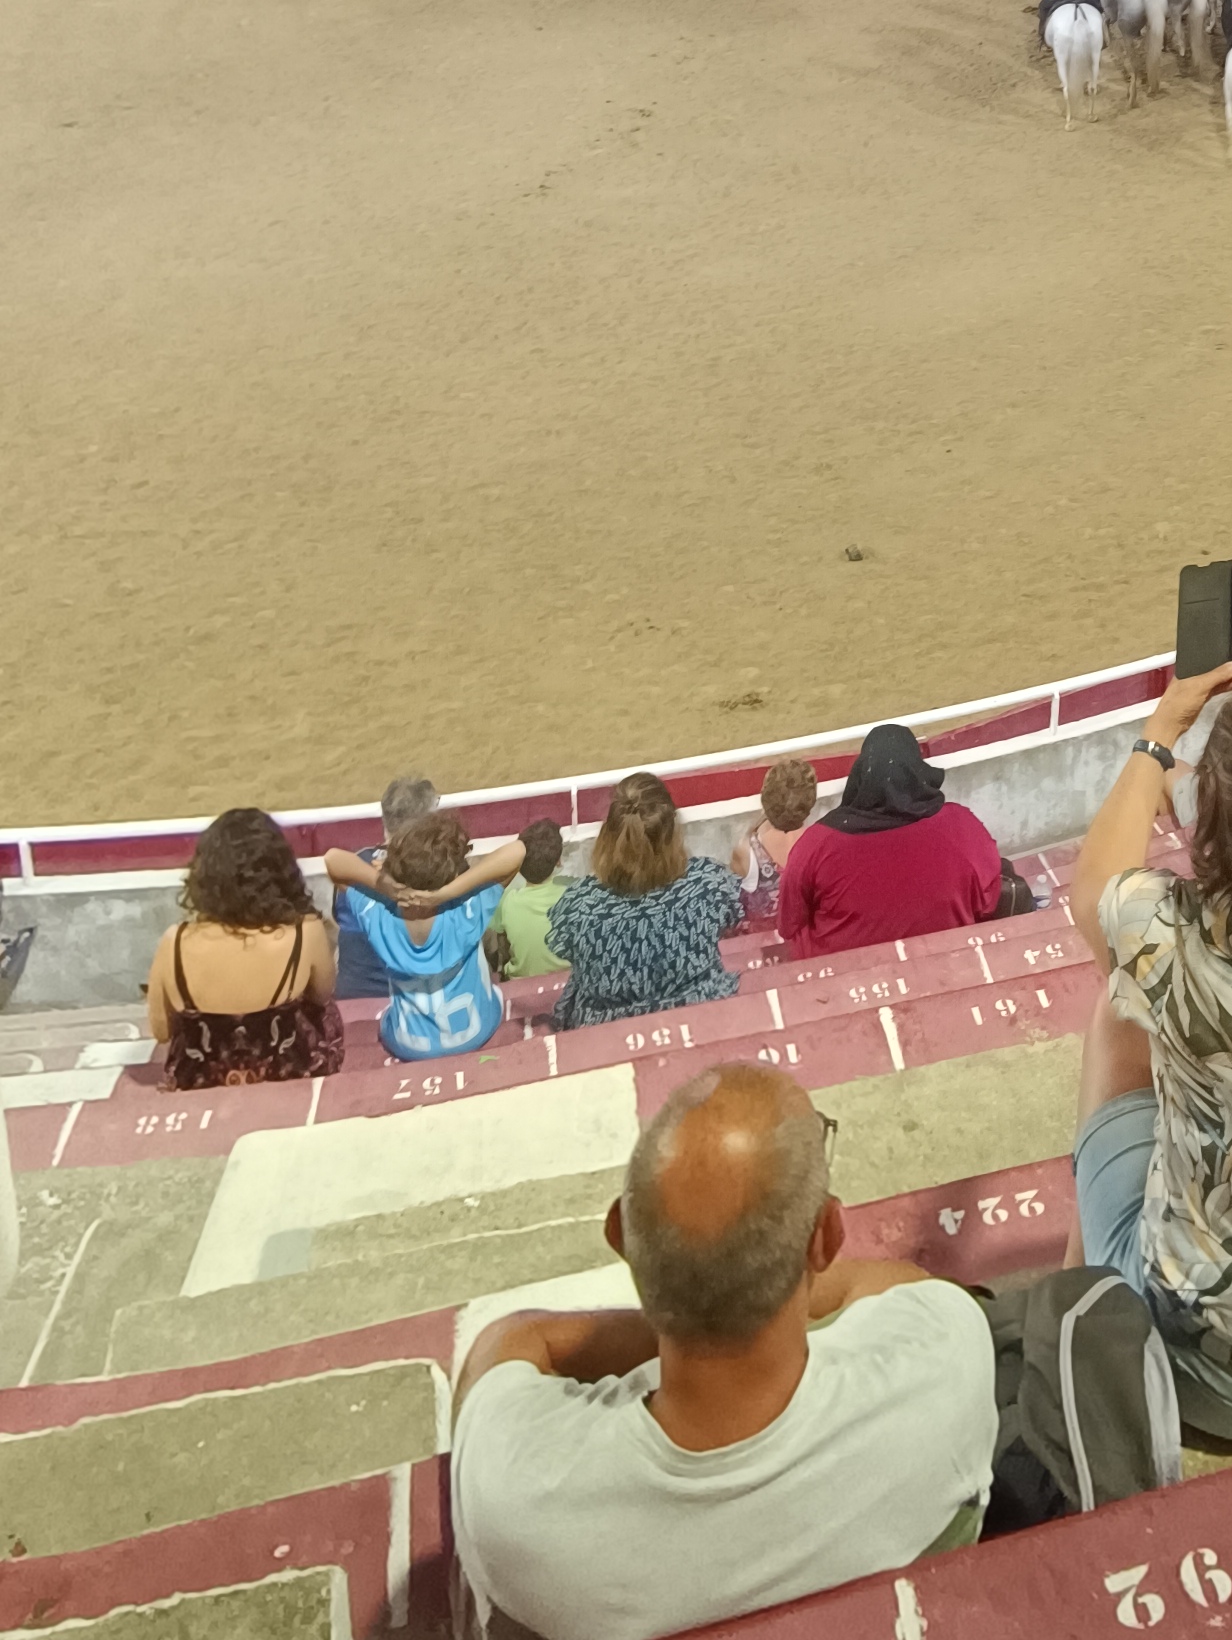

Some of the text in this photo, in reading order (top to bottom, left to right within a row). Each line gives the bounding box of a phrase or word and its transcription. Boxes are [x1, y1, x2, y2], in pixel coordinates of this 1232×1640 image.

[848, 977, 911, 1004] 155
[969, 988, 1054, 1027] 161
[624, 1023, 697, 1052] 156
[391, 1070, 469, 1101] 157
[134, 1109, 214, 1136] 158
[937, 1188, 1046, 1236] 224
